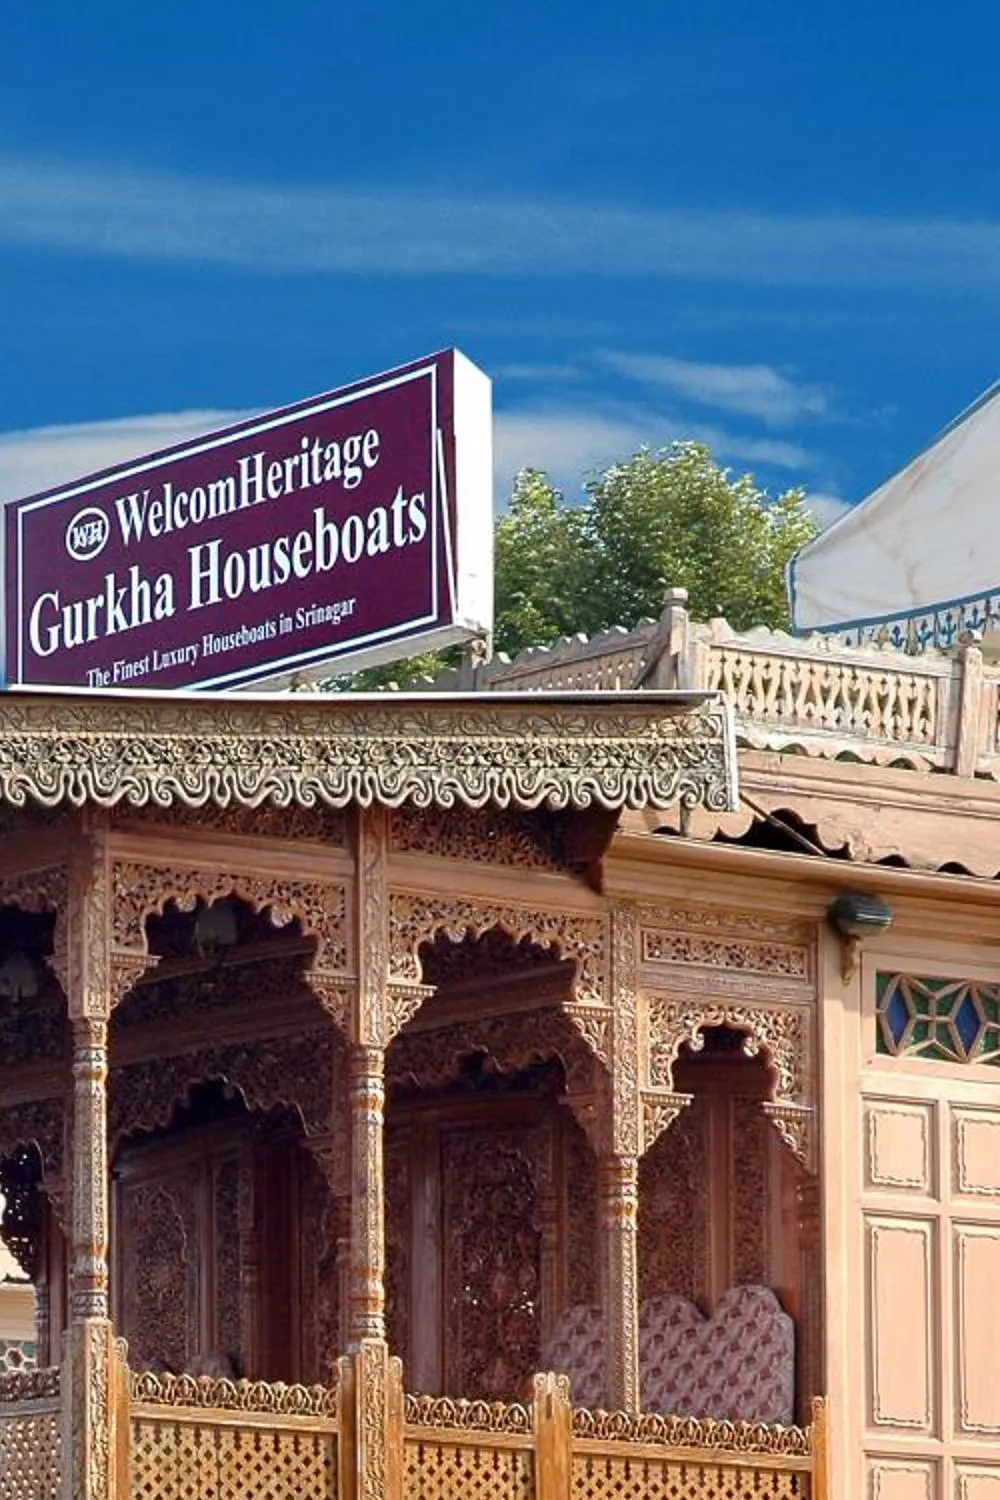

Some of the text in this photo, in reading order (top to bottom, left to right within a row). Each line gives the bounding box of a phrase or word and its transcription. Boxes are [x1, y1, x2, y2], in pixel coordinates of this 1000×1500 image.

[115, 429, 379, 547] WelcomHeritage
[29, 485, 427, 657] Gurkha Houseboats
[86, 598, 357, 688] The Finest Luxury Houseboats in Srinagar
